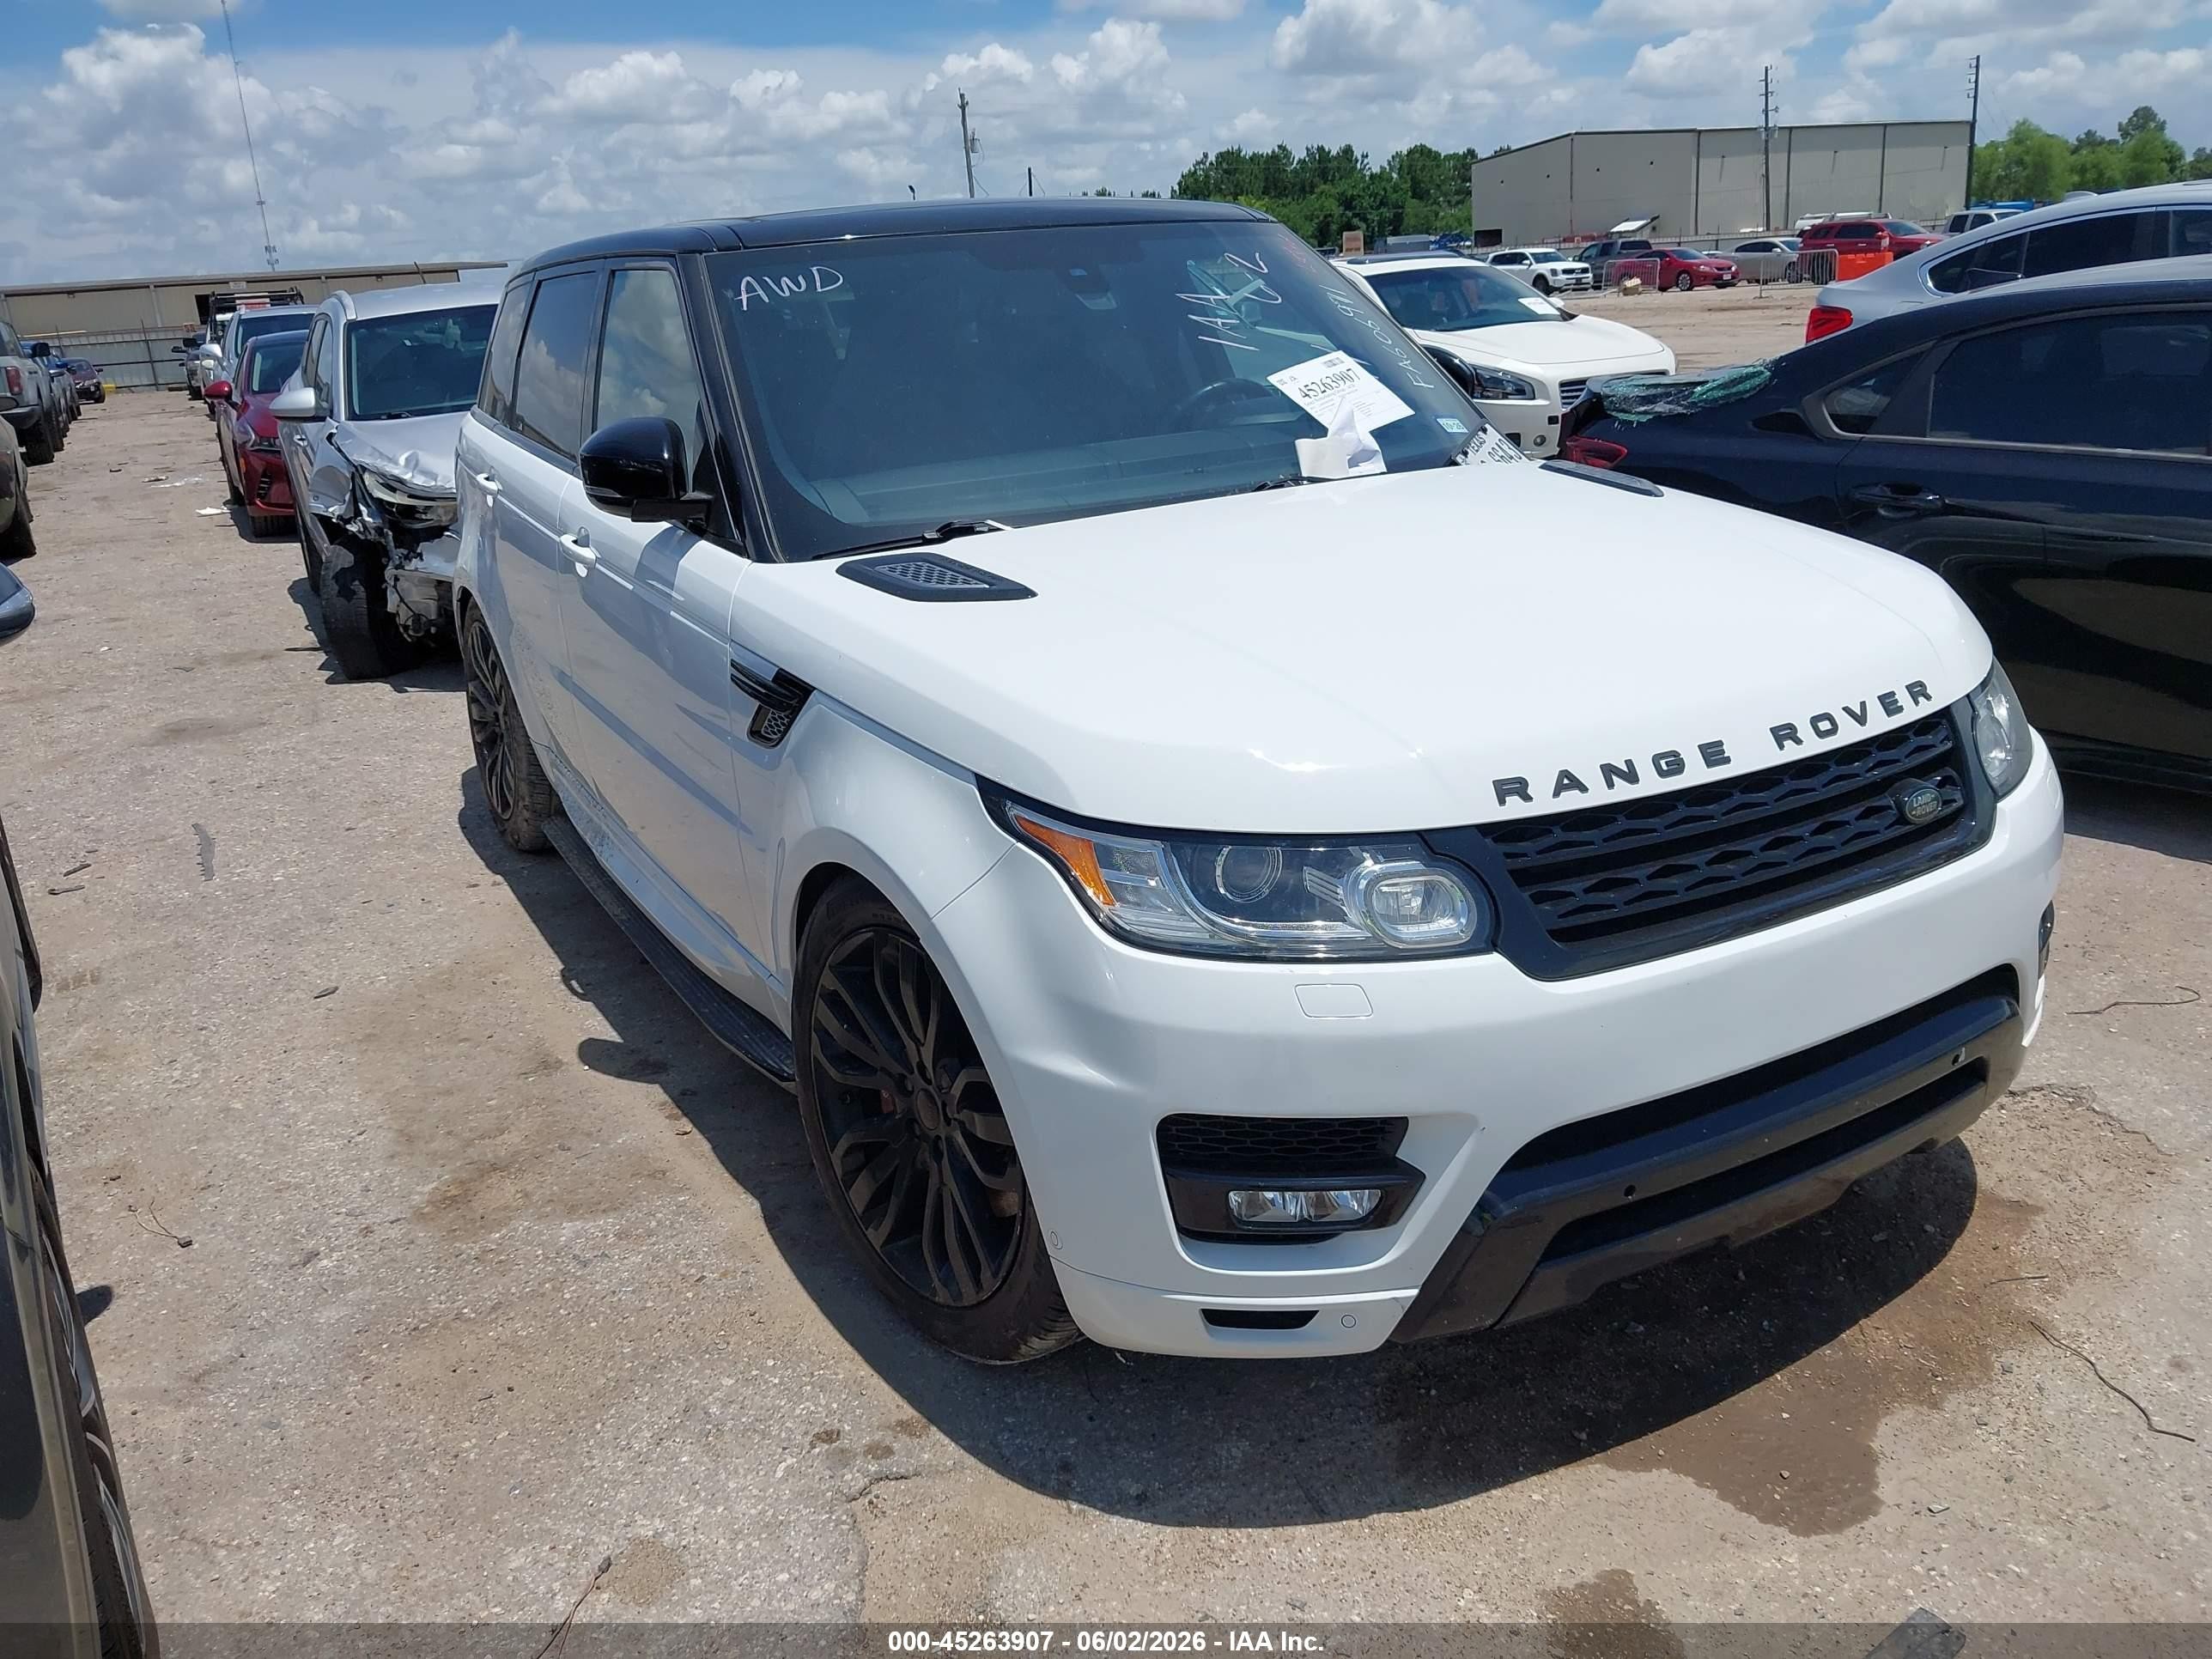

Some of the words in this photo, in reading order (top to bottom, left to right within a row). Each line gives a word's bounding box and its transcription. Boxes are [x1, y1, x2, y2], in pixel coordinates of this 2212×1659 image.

[733, 264, 844, 312] AWD
[1297, 368, 1361, 400] 45263907
[1468, 434, 1486, 456] TEXAS
[1492, 739, 1732, 807] RANGE
[1769, 679, 1934, 751] ROVER
[1912, 793, 1931, 807] LAND
[1916, 800, 1938, 817] ROVER
